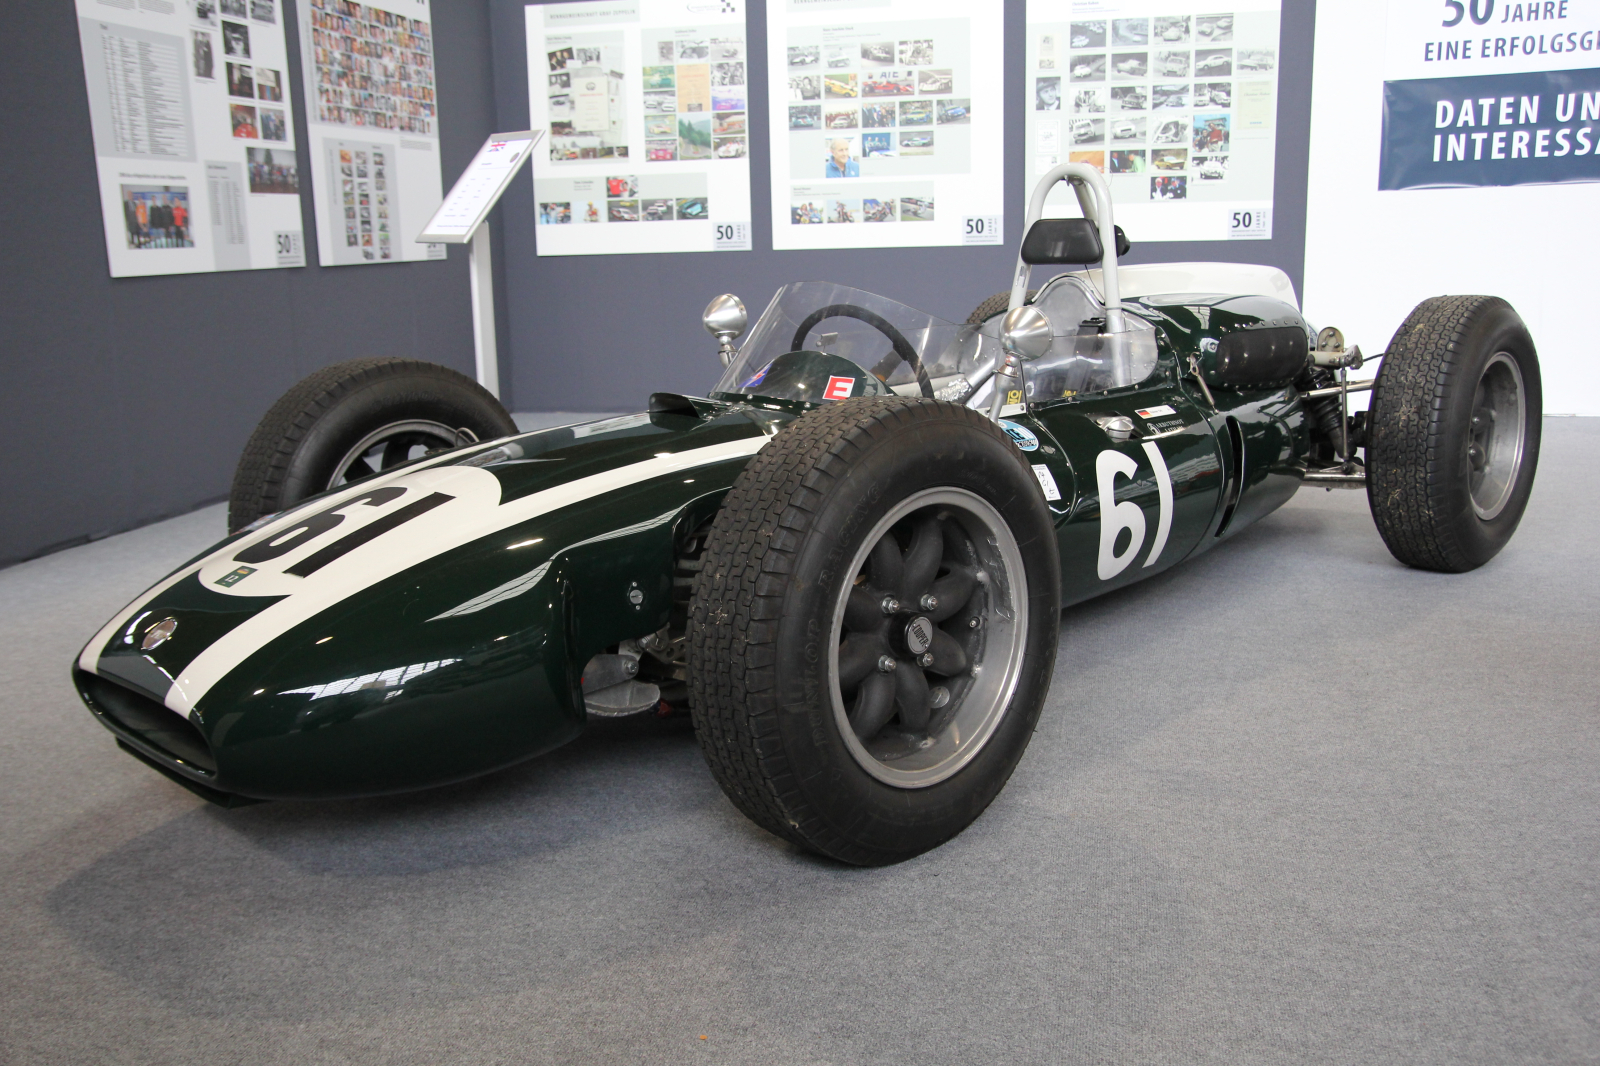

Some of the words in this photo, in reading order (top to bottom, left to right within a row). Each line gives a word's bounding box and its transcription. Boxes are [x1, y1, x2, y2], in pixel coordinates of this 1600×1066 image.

[1501, 0, 1568, 23] JAHRE
[1424, 39, 1472, 62] EINE
[1435, 95, 1540, 129] DATEN
[1555, 91, 1600, 122] UN
[966, 218, 984, 234] 50
[1232, 212, 1252, 228] 50
[716, 224, 734, 240] 50
[278, 234, 291, 254] 50
[824, 376, 854, 400] E
[1096, 441, 1174, 580] 61
[232, 486, 457, 578] 61
[912, 624, 930, 647] COOPER
[804, 618, 829, 747] DUNLOP
